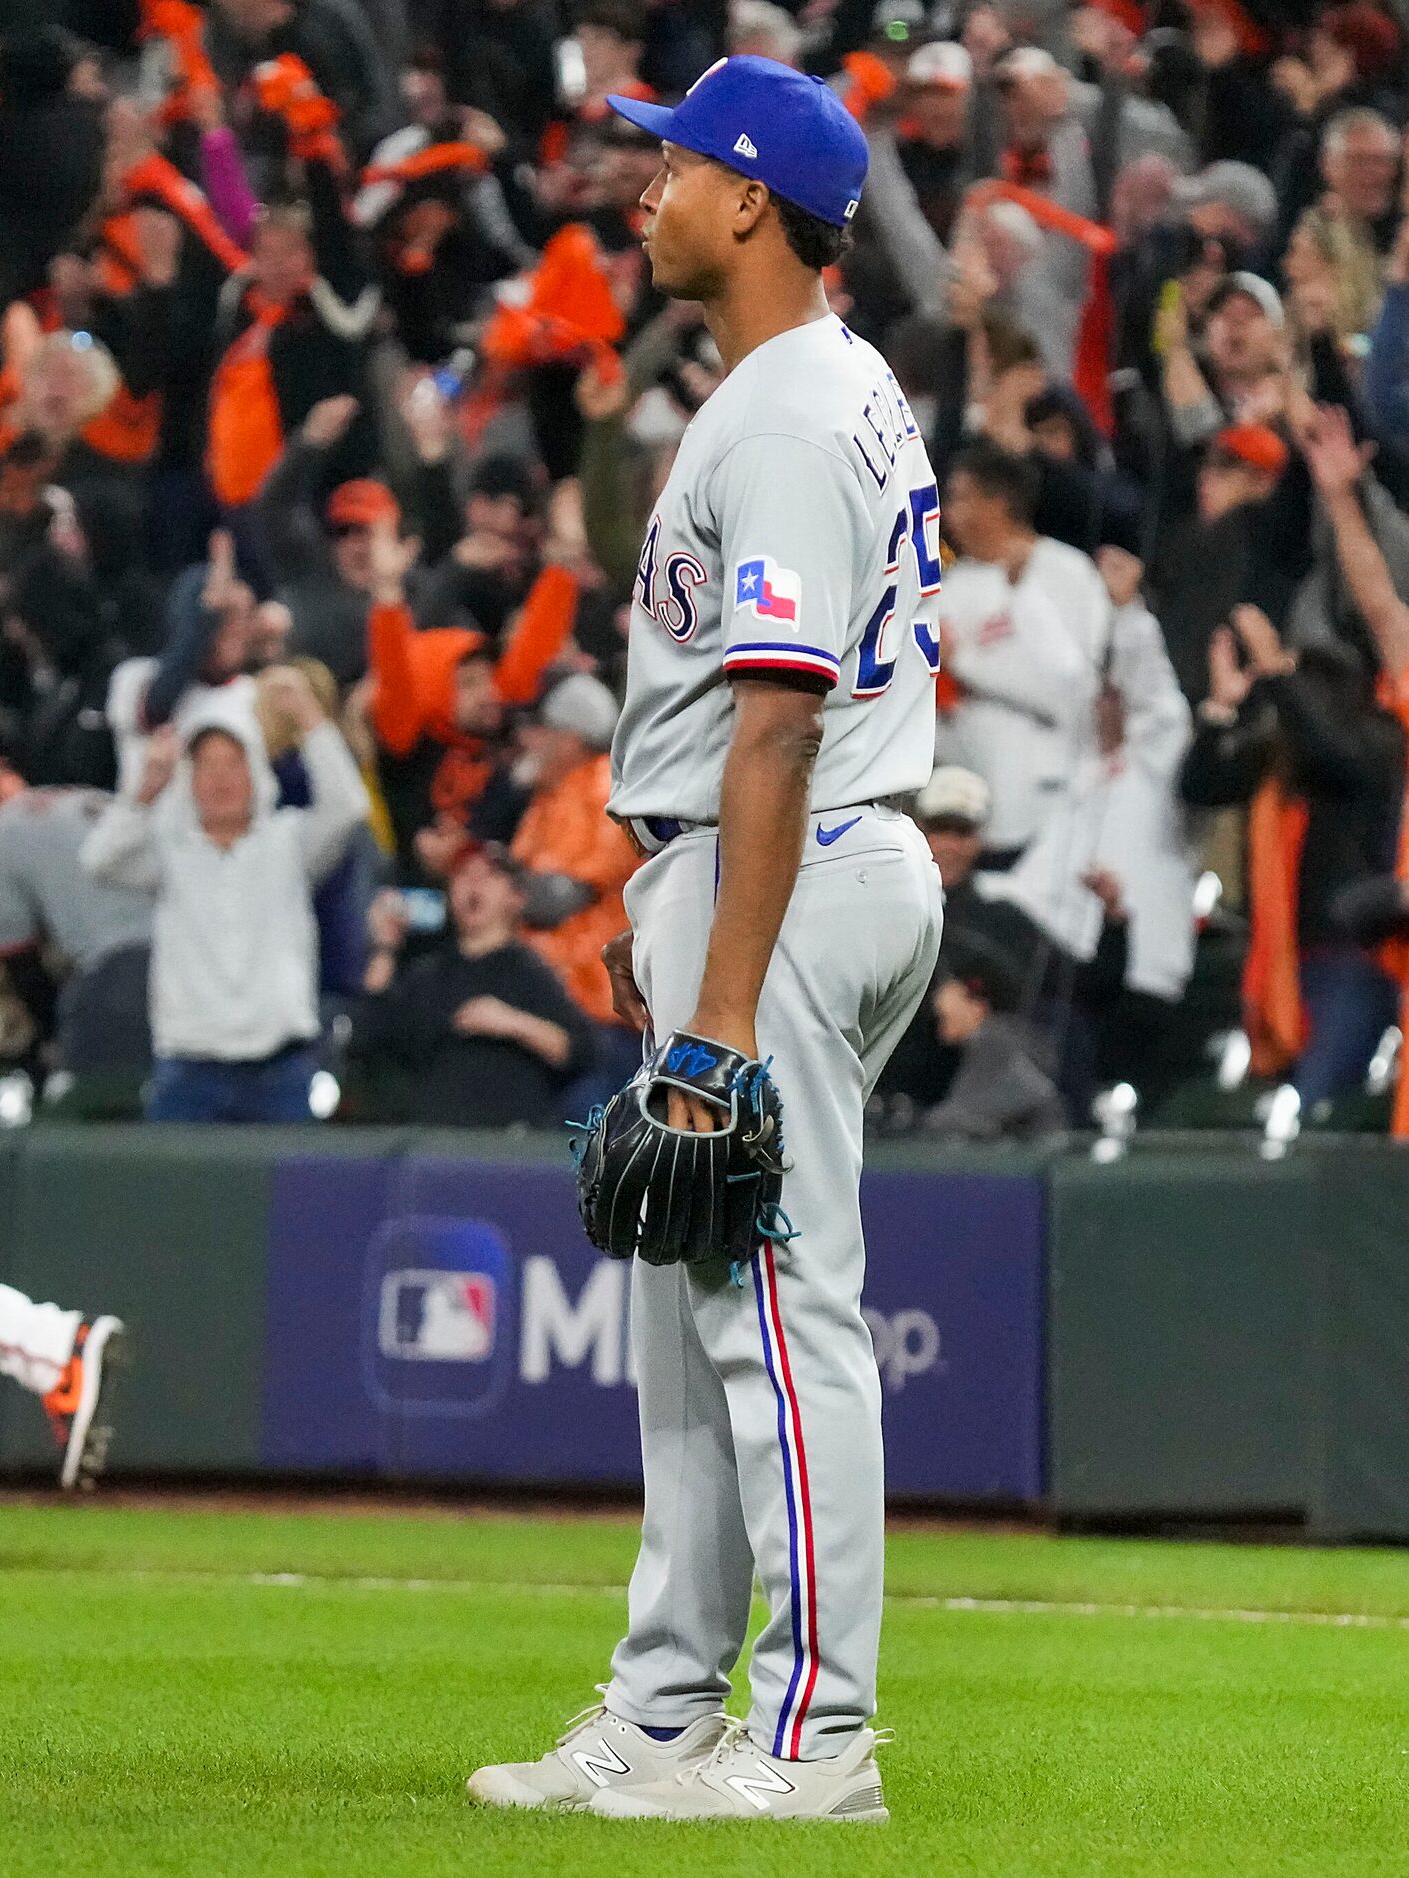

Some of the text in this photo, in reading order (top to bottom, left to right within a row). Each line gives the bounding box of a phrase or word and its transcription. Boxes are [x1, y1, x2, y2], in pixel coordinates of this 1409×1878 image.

[637, 513, 708, 643] AS
[850, 484, 941, 699] 25
[519, 1254, 639, 1388] M
